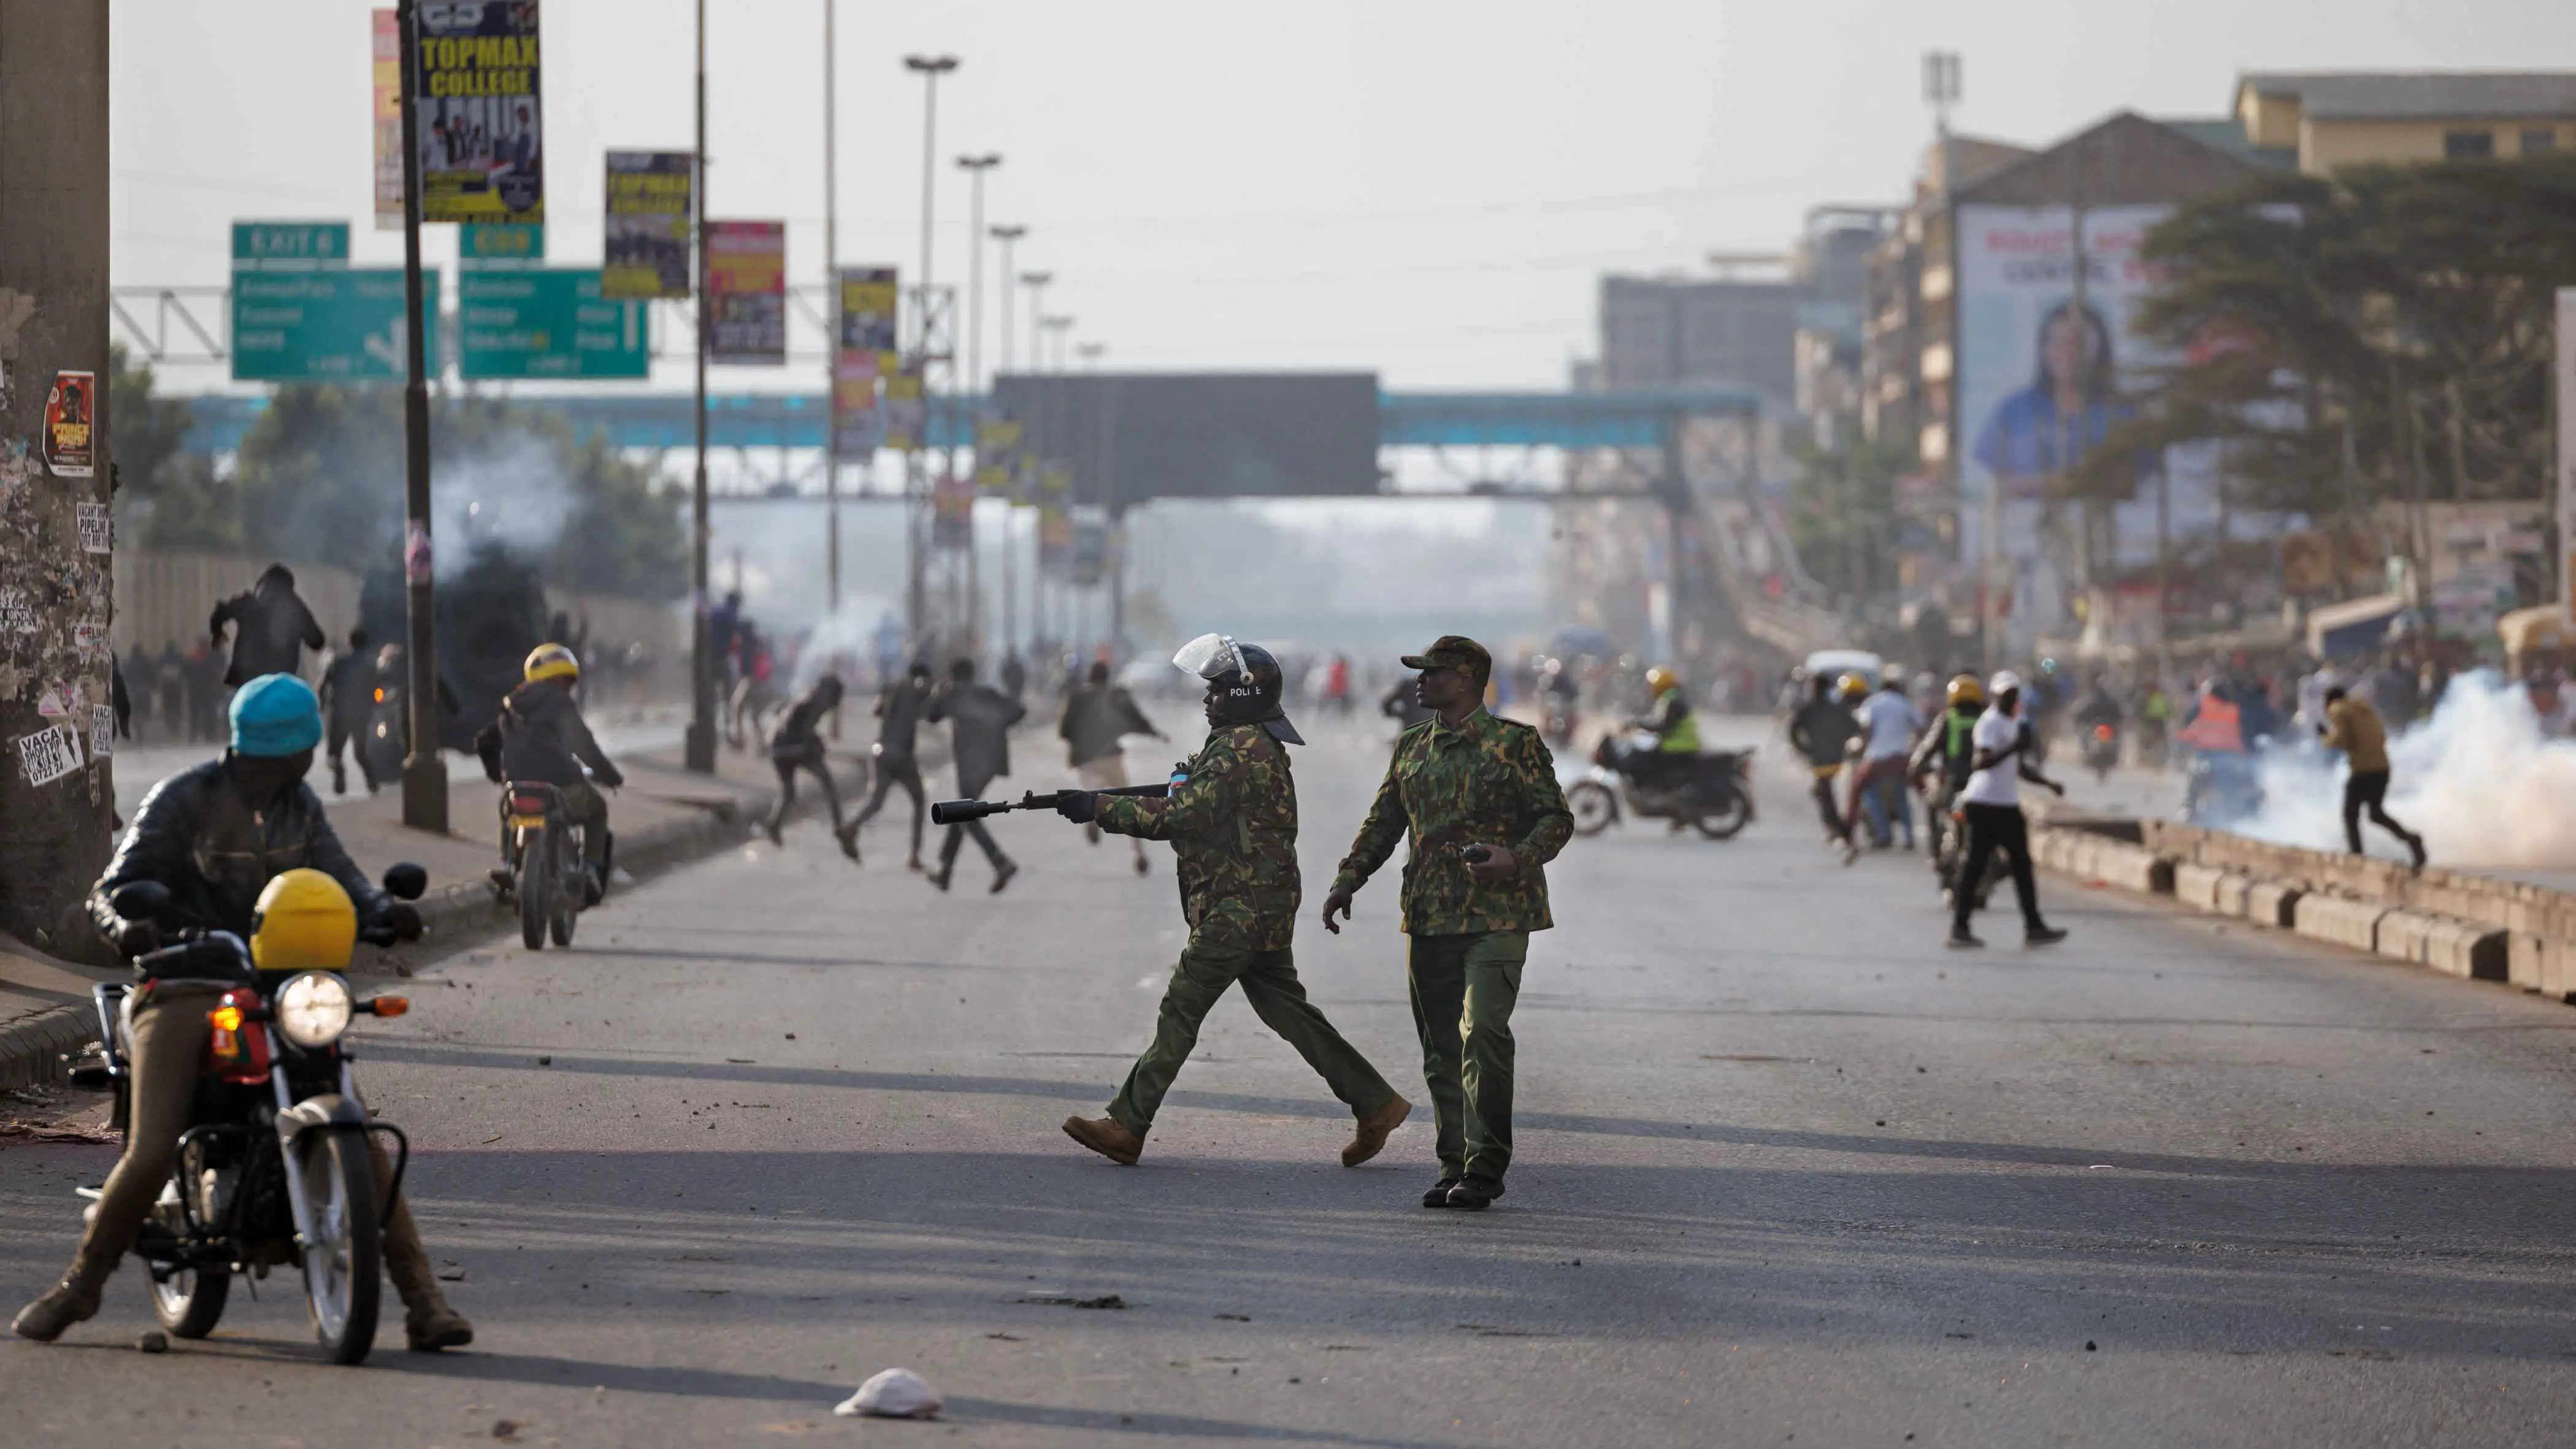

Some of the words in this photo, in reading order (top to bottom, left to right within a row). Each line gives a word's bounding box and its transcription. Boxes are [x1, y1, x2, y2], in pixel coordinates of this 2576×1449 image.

[421, 36, 539, 70] TOPMAX
[431, 70, 532, 97] COLLEGE
[250, 231, 309, 254] EXIT
[78, 503, 98, 517] VACANT
[80, 519, 106, 534] PIPELINE
[1230, 686, 1261, 697] POLIE
[33, 765, 53, 781] 0722
